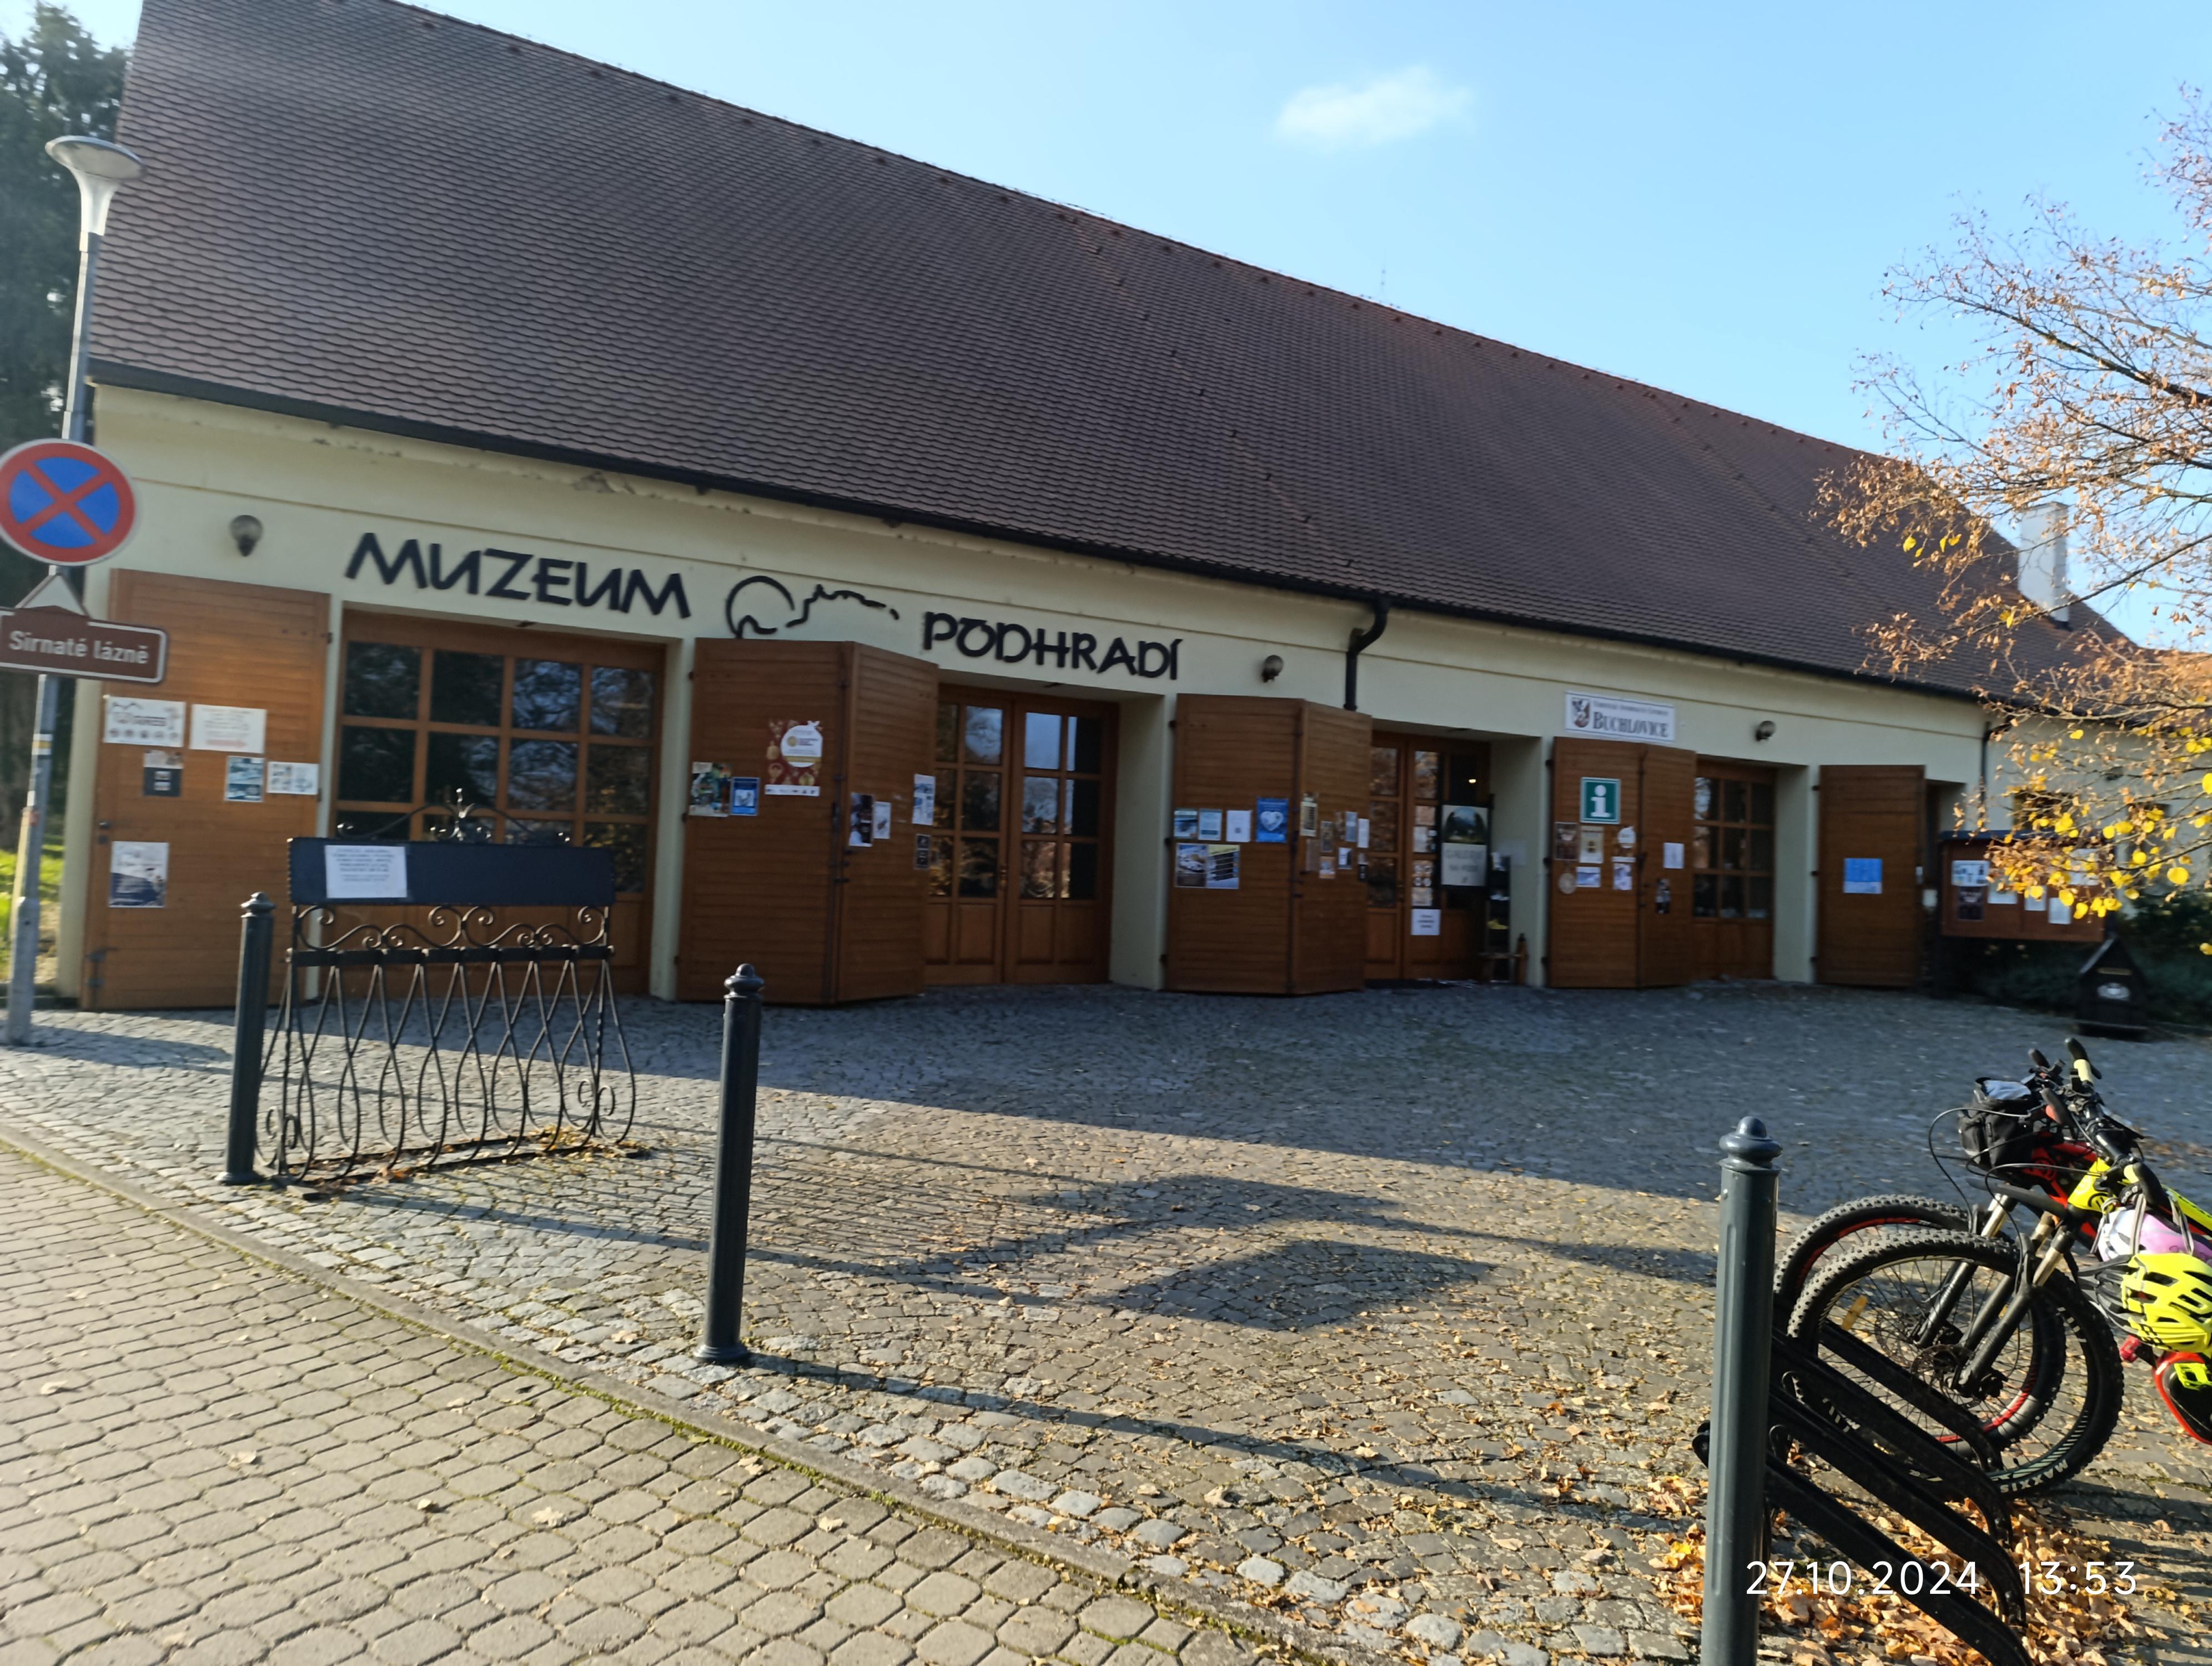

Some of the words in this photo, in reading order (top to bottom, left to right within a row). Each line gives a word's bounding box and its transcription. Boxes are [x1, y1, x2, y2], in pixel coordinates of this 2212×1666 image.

[345, 532, 691, 619] MUZEUM
[922, 611, 1184, 680] PODHRADÍ
[9, 630, 88, 657] Sirnaté
[93, 640, 149, 664] lázně
[1999, 1459, 2069, 1493] MAXXIS
